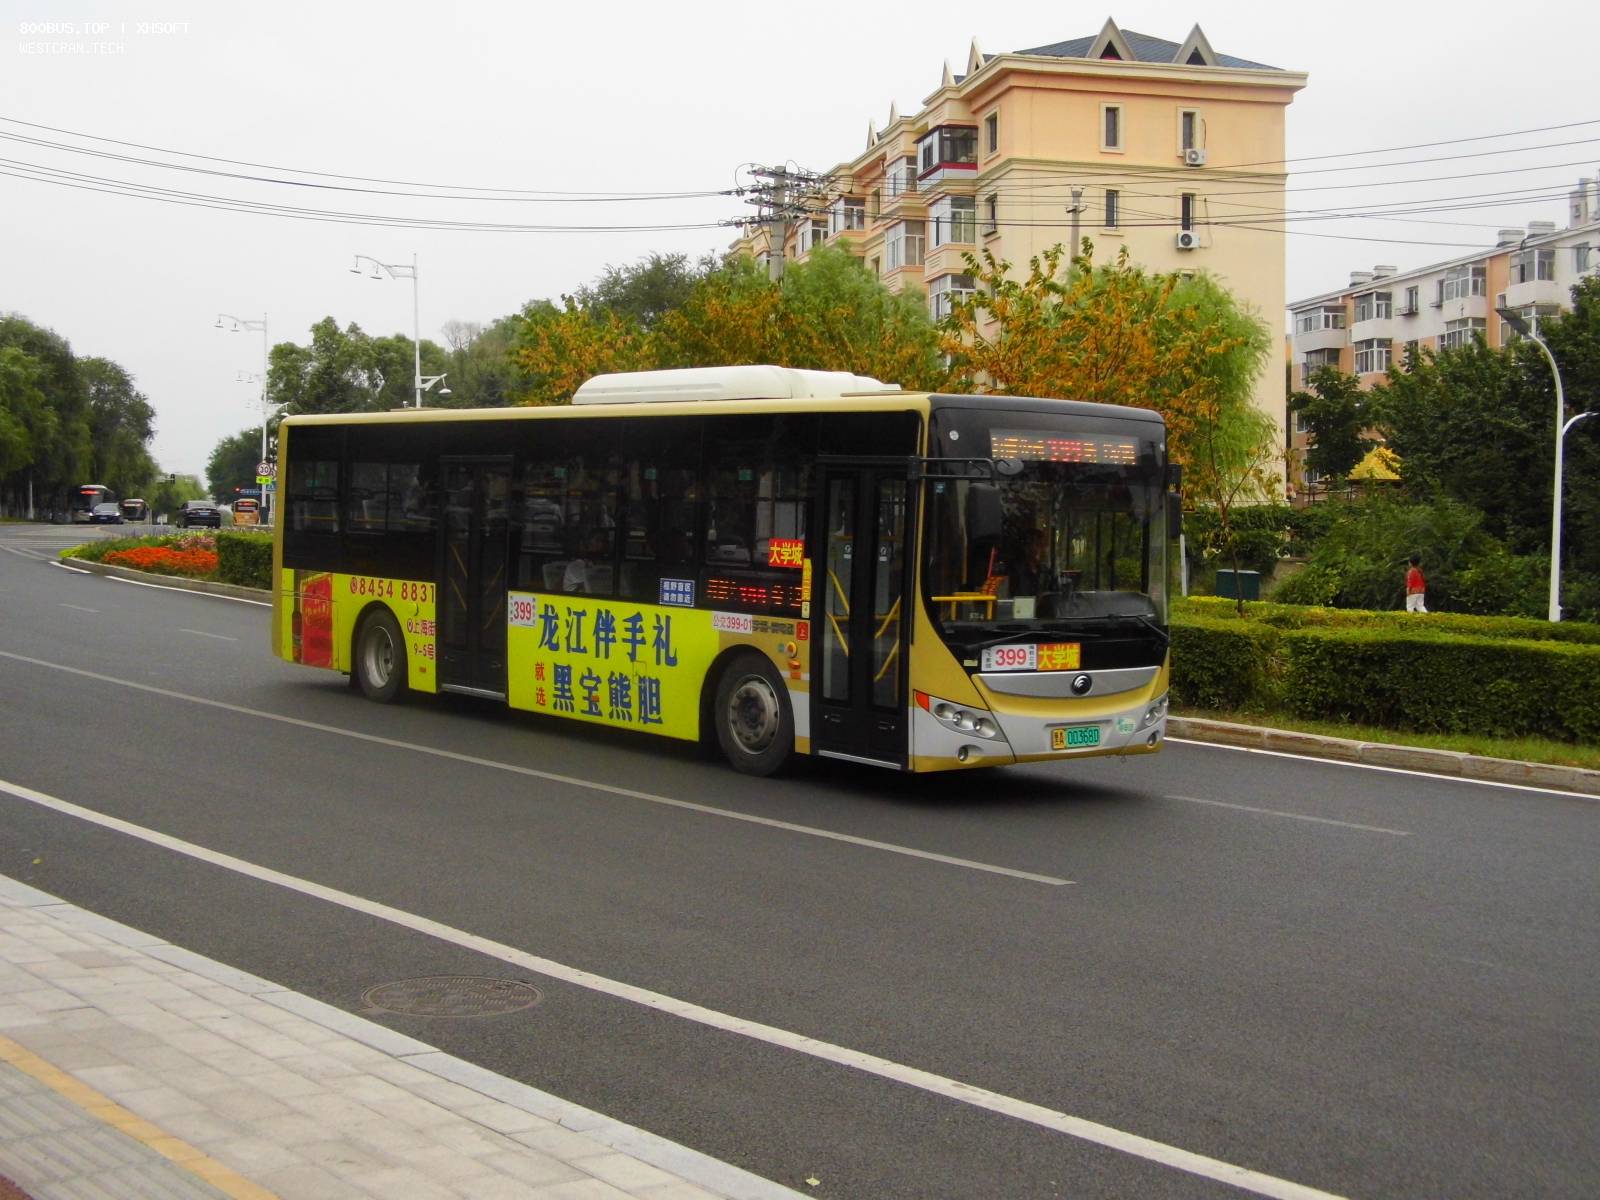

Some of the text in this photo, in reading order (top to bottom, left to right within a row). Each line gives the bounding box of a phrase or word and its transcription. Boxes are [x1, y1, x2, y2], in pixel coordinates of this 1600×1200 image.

[769, 541, 803, 566] 大学城
[360, 577, 434, 604] 8454 8831
[513, 601, 532, 620] 399
[538, 603, 678, 667] 龙江伴手礼
[995, 648, 1027, 666] 399
[1038, 644, 1079, 669] 大学城
[535, 661, 547, 706] 就选
[552, 662, 664, 724] 黑宝熊胆
